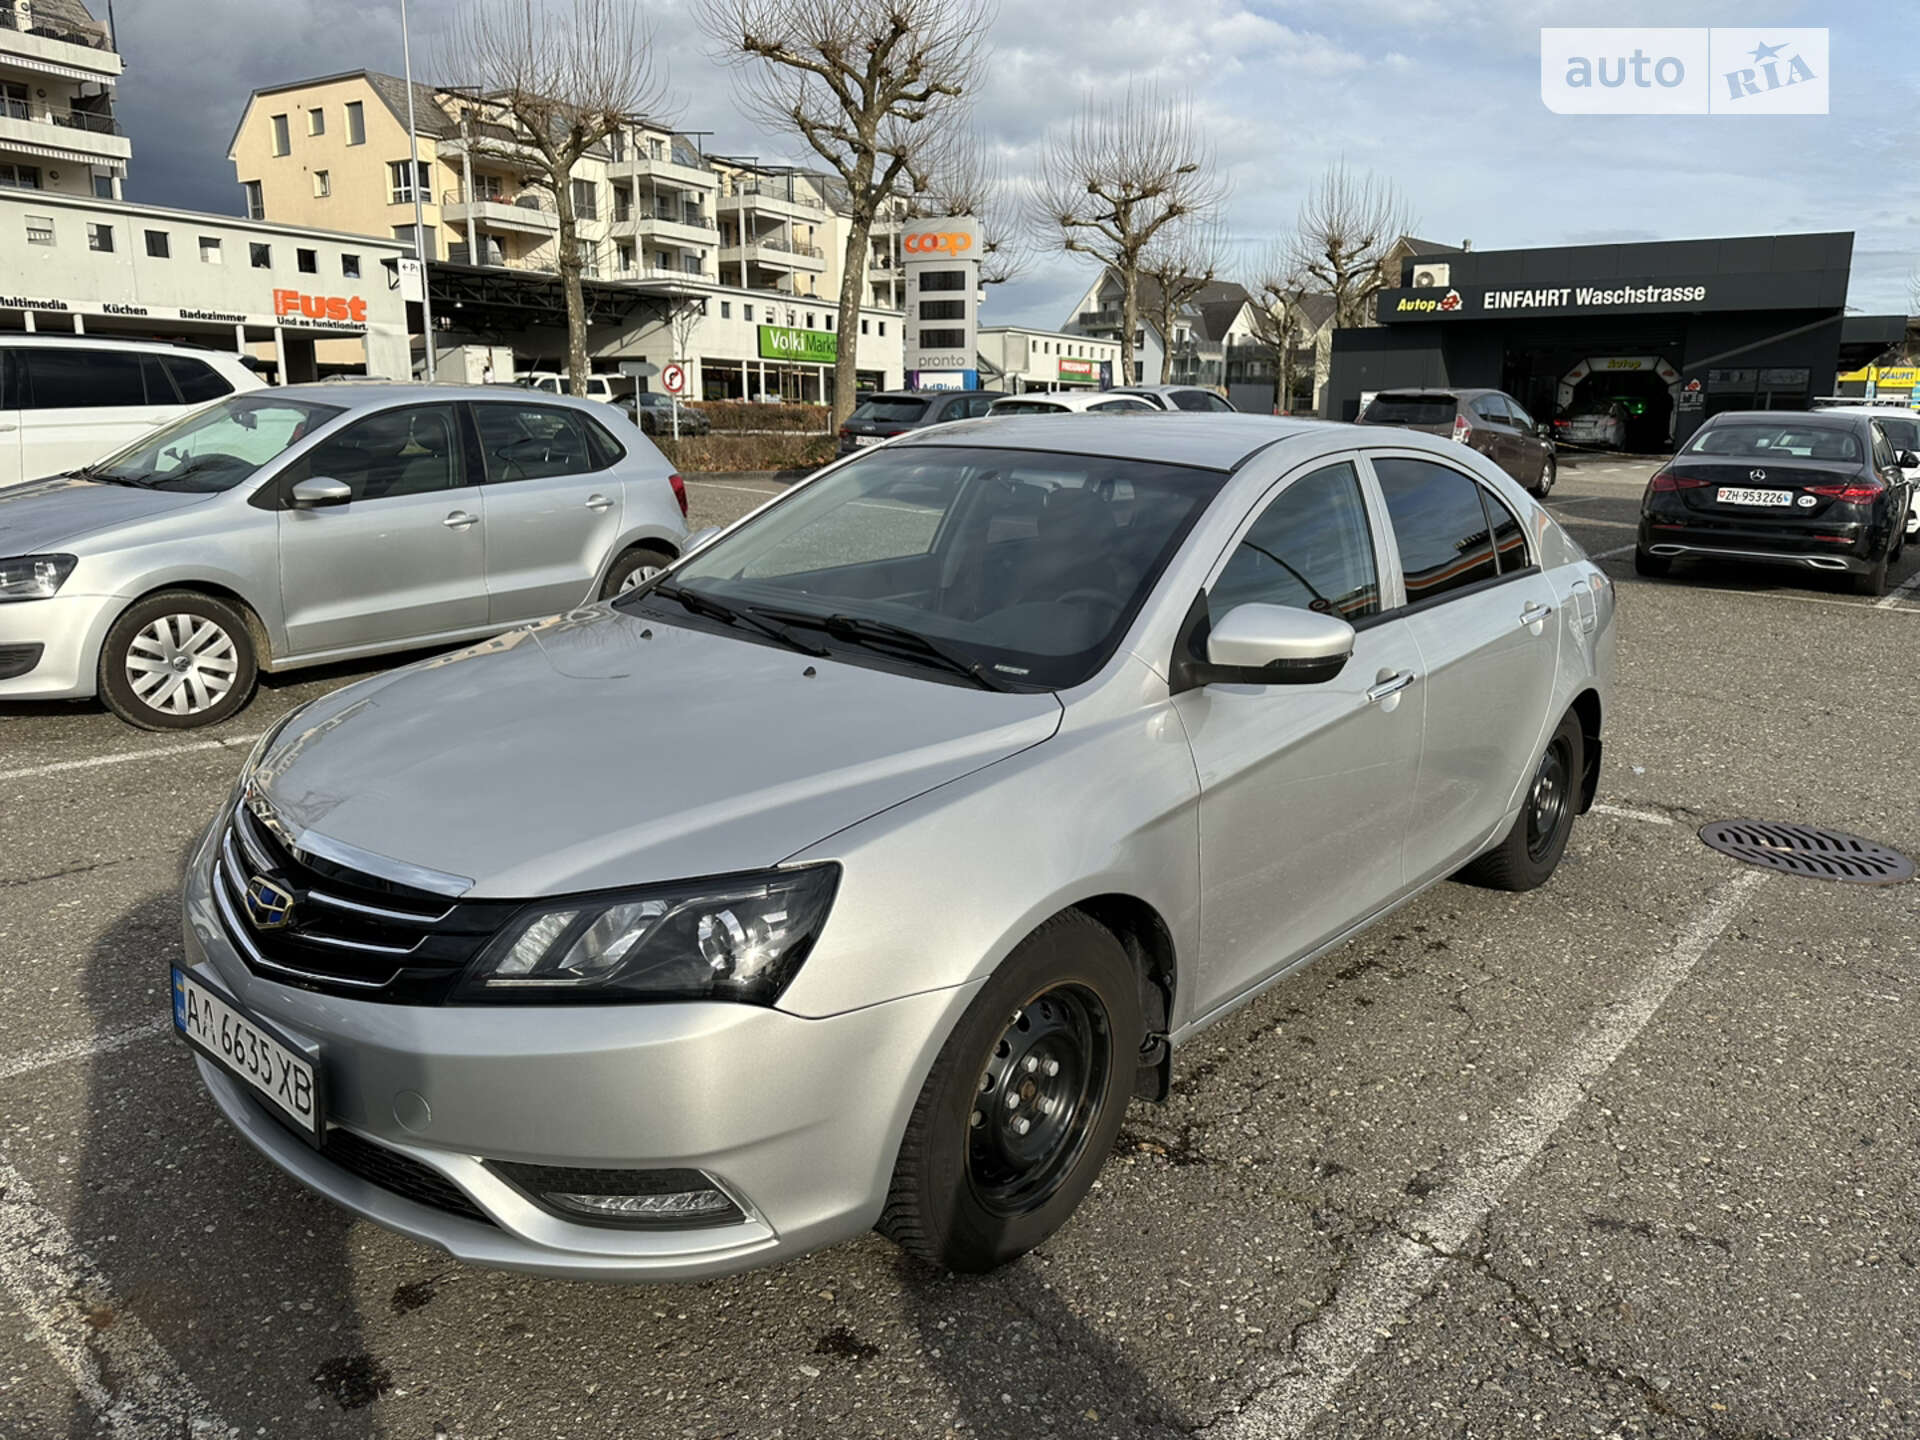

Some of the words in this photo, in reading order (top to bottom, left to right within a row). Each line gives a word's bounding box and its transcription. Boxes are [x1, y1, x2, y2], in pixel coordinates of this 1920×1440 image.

[904, 232, 972, 257] coop
[273, 288, 368, 322] Fust
[1396, 297, 1437, 313] Autop
[1483, 288, 1571, 310] EINFAHRT
[1575, 285, 1706, 306] Waschstrasse
[102, 303, 148, 316] Küchen
[179, 309, 247, 323] Badezimmer
[277, 316, 297, 327] Und
[769, 329, 805, 351] Volki
[919, 354, 966, 369] pronto
[188, 988, 217, 1045] AA
[222, 1013, 272, 1085] 6635
[276, 1050, 311, 1115] XB
